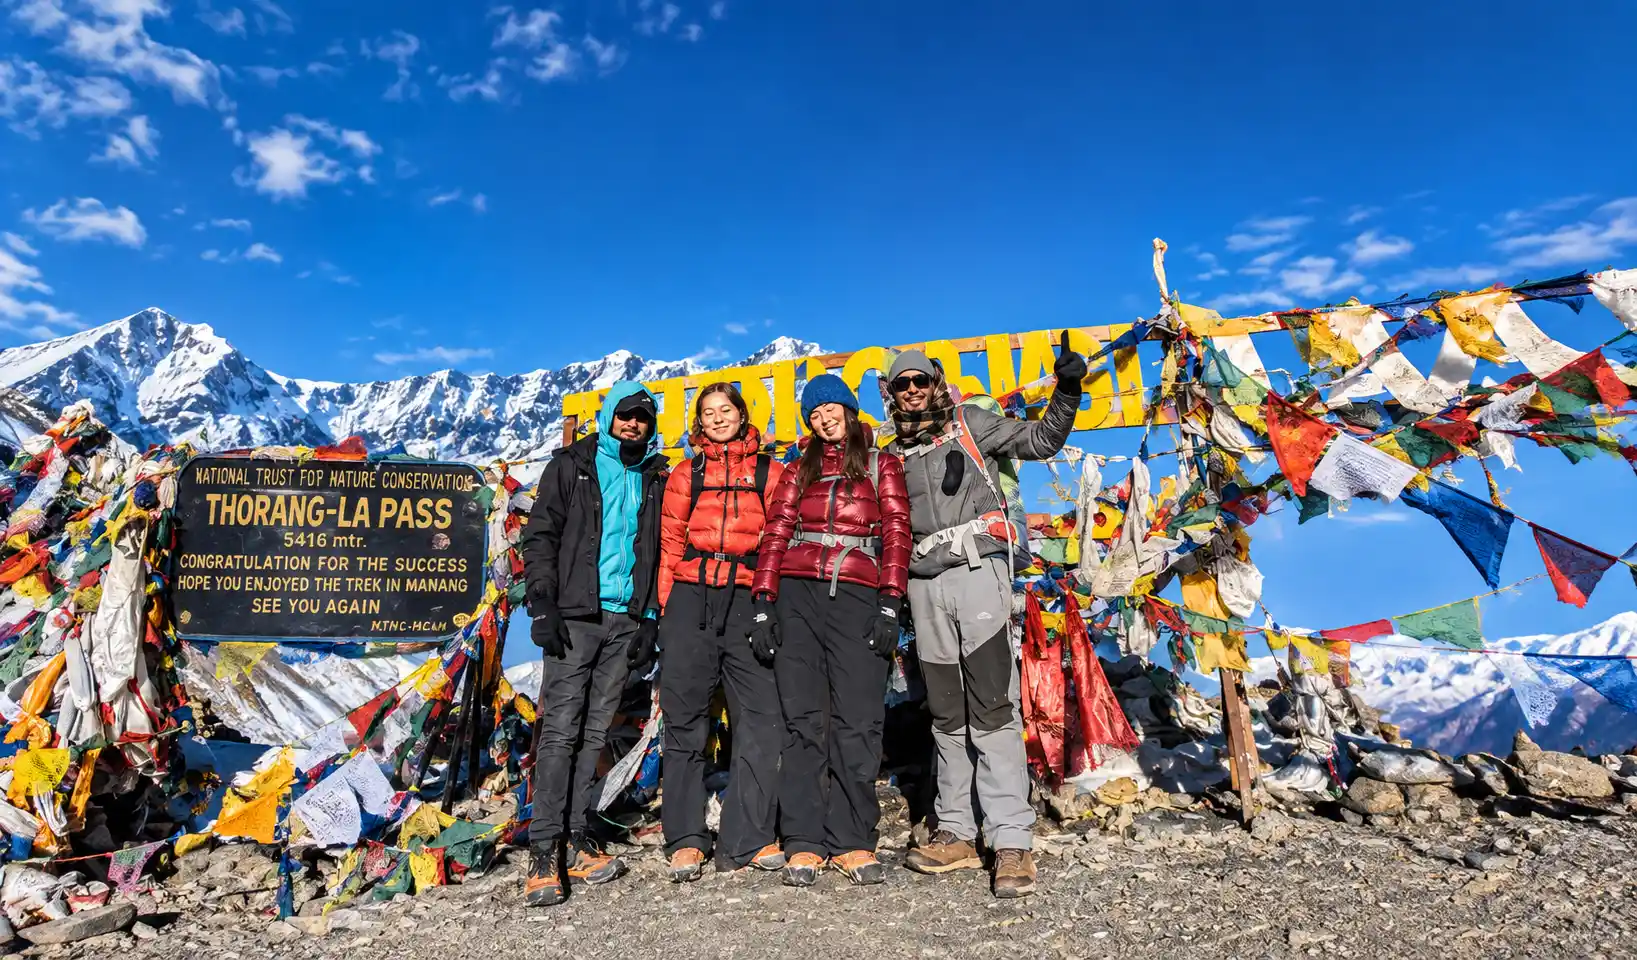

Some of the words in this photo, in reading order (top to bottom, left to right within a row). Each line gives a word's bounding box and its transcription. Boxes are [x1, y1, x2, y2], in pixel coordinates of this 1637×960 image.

[195, 467, 250, 486] NATIONAL
[255, 467, 295, 486] TRUST
[329, 469, 377, 489] NATURE
[205, 493, 371, 528] THORANG-LA
[378, 497, 453, 530] PASS
[283, 531, 328, 549] 5416
[332, 534, 367, 549] mtr.
[179, 553, 311, 572] CONGRATULATION
[317, 555, 349, 572] FOR
[356, 556, 389, 573] THE
[395, 557, 468, 573] SUCCESS
[177, 575, 211, 591] HOPE
[215, 575, 242, 592] YOU
[245, 576, 310, 592] ENJOYED
[314, 577, 342, 593] THE
[345, 577, 381, 593] TREK
[386, 577, 401, 593] IN
[405, 577, 468, 593] MANANG
[251, 597, 281, 614] SEE
[288, 598, 321, 614] YOU
[325, 598, 381, 614] AGAIN
